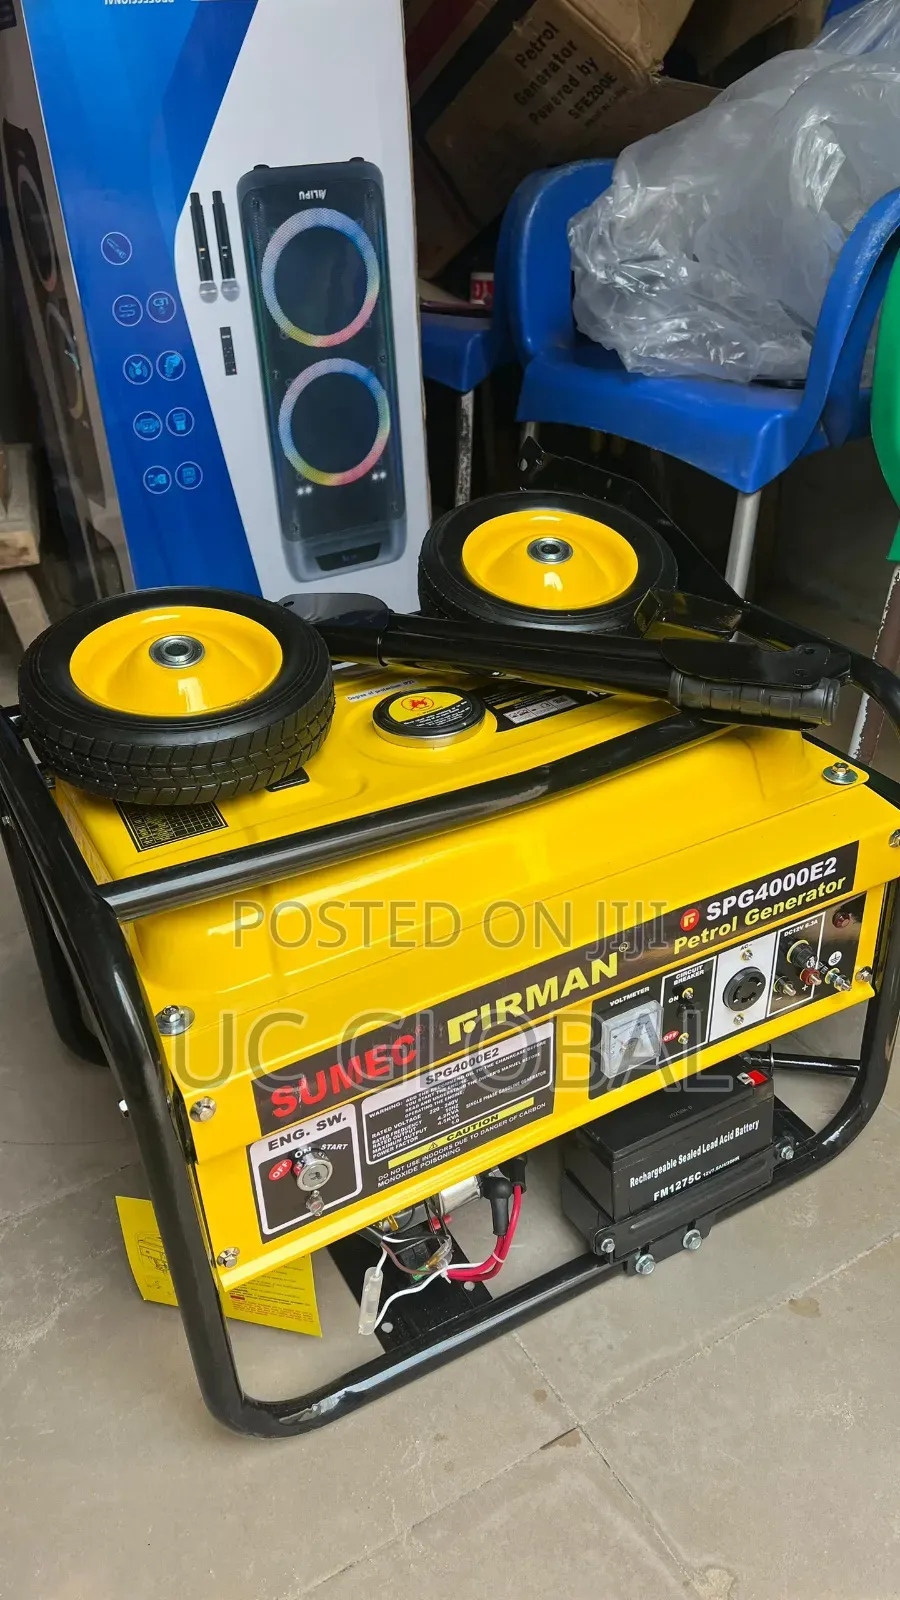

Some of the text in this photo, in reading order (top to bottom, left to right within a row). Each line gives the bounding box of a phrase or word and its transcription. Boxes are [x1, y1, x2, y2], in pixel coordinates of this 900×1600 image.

[514, 21, 559, 69] Petrol
[514, 40, 577, 105] Generator
[529, 56, 599, 125] Powered by
[568, 72, 617, 119] SFE200E
[706, 856, 837, 921] SPG4000E2
[674, 876, 846, 955] Petrol Generator
[674, 970, 704, 985] BREAKER
[676, 964, 703, 980] CIRCUIT
[447, 952, 617, 1045] FIRMAN
[610, 986, 650, 1007] VOLTMETER
[668, 996, 679, 1004] ON
[664, 1032, 678, 1042] OFF
[271, 1034, 417, 1118] SUMEC
[426, 1047, 499, 1084] SPG4000E2
[369, 1100, 402, 1119] WARNING:
[484, 1062, 494, 1070] THE
[406, 1099, 416, 1107] YOU
[418, 1092, 434, 1102] START
[404, 1103, 432, 1118] OPERATING
[434, 1098, 443, 1106] THE
[268, 1112, 347, 1152] ENG. SW.
[371, 1126, 392, 1139] RATED
[393, 1113, 421, 1129] VOLTAGE
[372, 1134, 389, 1145] RATED
[390, 1119, 422, 1137] FREQUENCY
[372, 1137, 391, 1149] RATED
[392, 1126, 416, 1140] OUTPUT
[372, 1138, 401, 1154] MAXIMUM
[403, 1126, 427, 1140] OUTPUT
[378, 1101, 545, 1181] DO NOT USE INDOORS DUE TO DANGER OF CARBON
[446, 1114, 499, 1142] CAUTION
[372, 1146, 393, 1159] POWER
[395, 1135, 418, 1149] FACTOR
[630, 1119, 759, 1188] Rechargeable Sealed Lead Acid Battery
[272, 1161, 288, 1178] OFF
[377, 1146, 460, 1188] MONOXIDE POISONING
[654, 1171, 702, 1201] FM1275C
